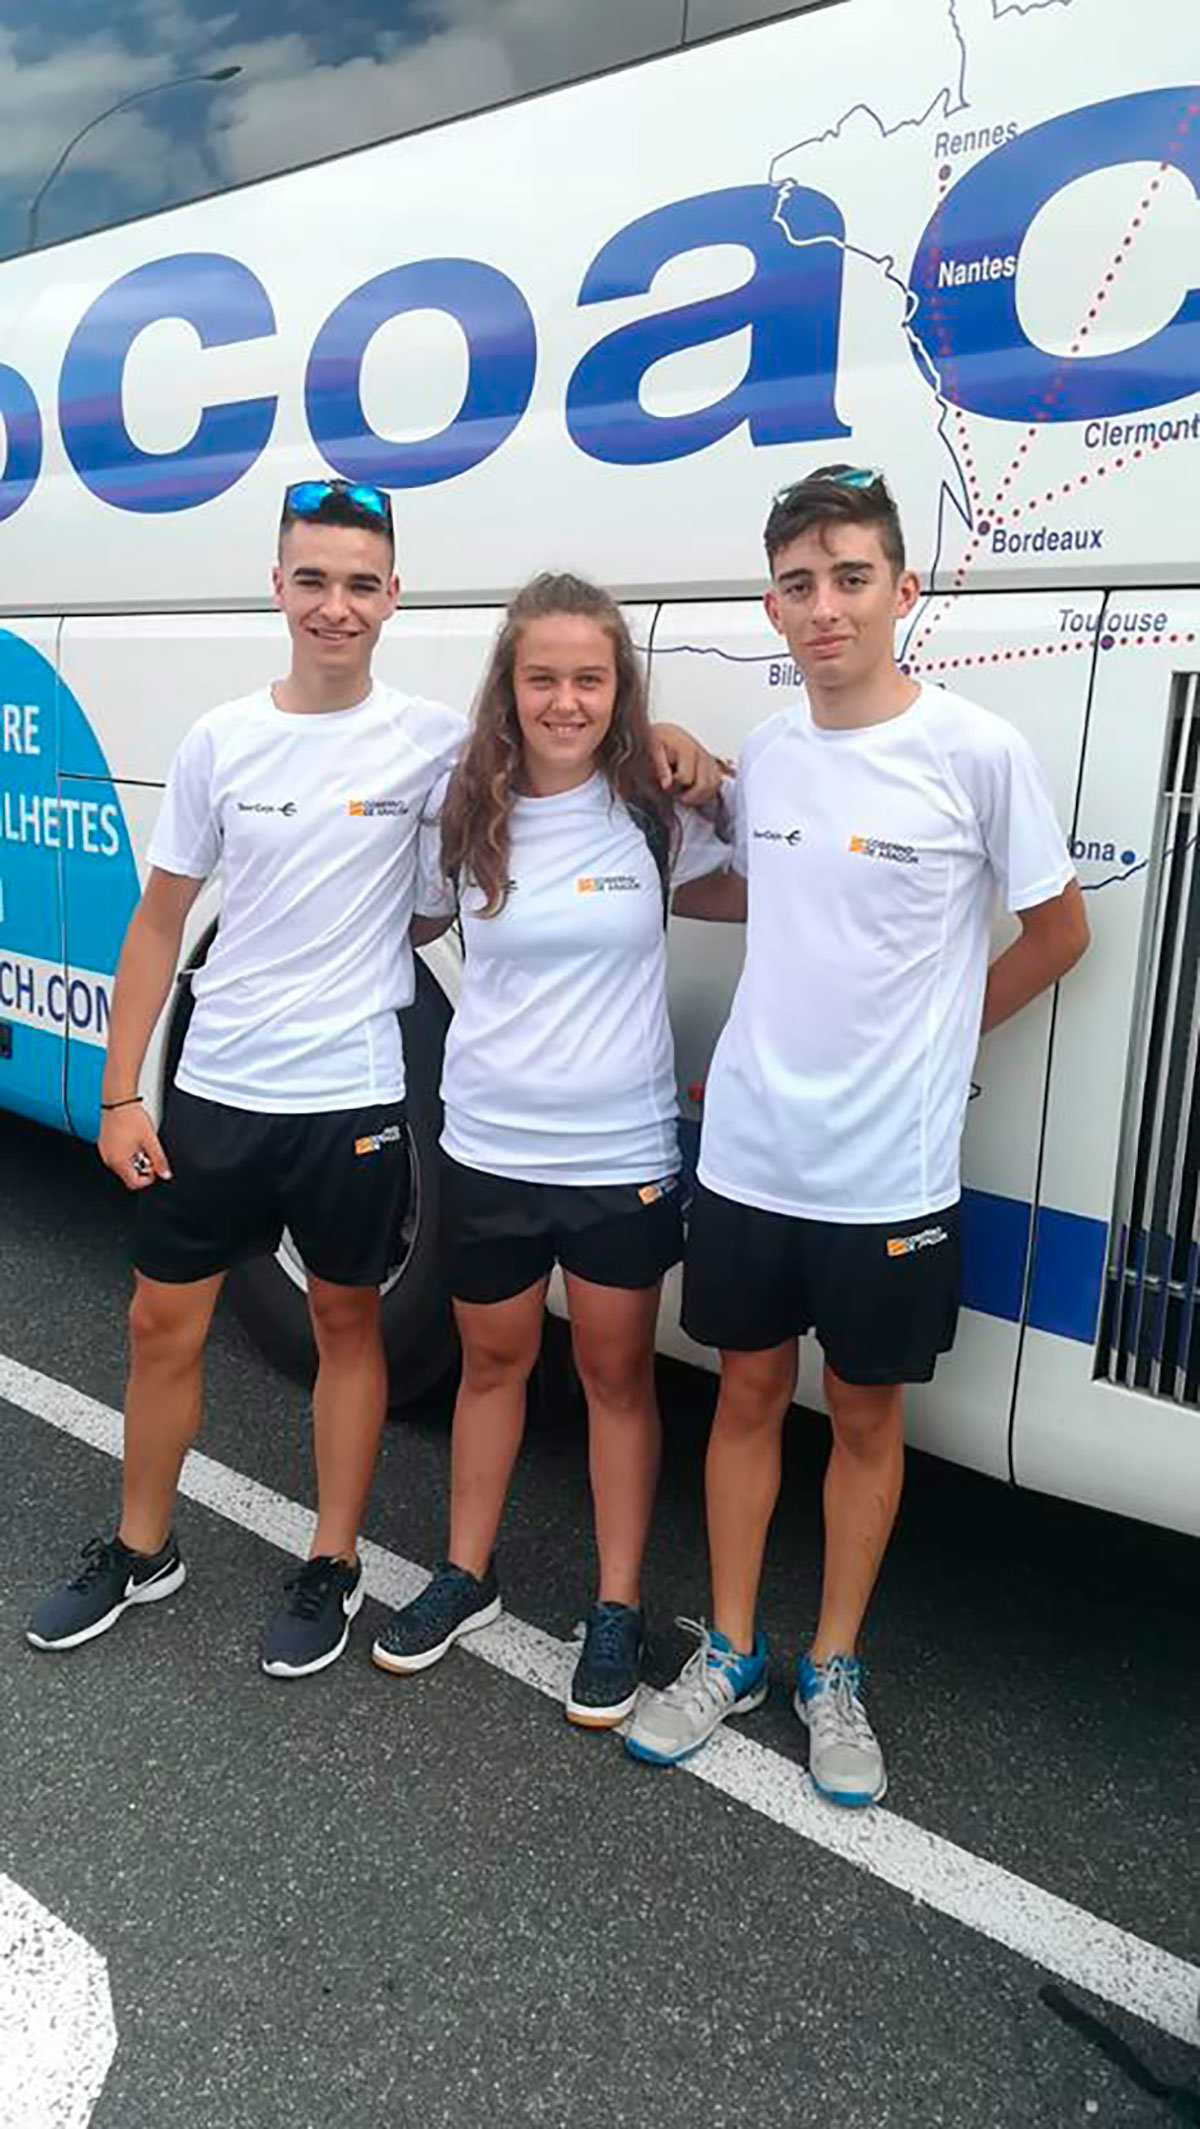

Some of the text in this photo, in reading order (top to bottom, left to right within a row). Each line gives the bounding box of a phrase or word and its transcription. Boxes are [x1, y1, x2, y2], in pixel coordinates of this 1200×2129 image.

[935, 122, 1018, 158] Rennes
[939, 255, 1016, 288] Nantes
[1084, 413, 1200, 449] Clermont
[992, 526, 1103, 553] Bordeaux
[1059, 609, 1168, 633] Toulouse
